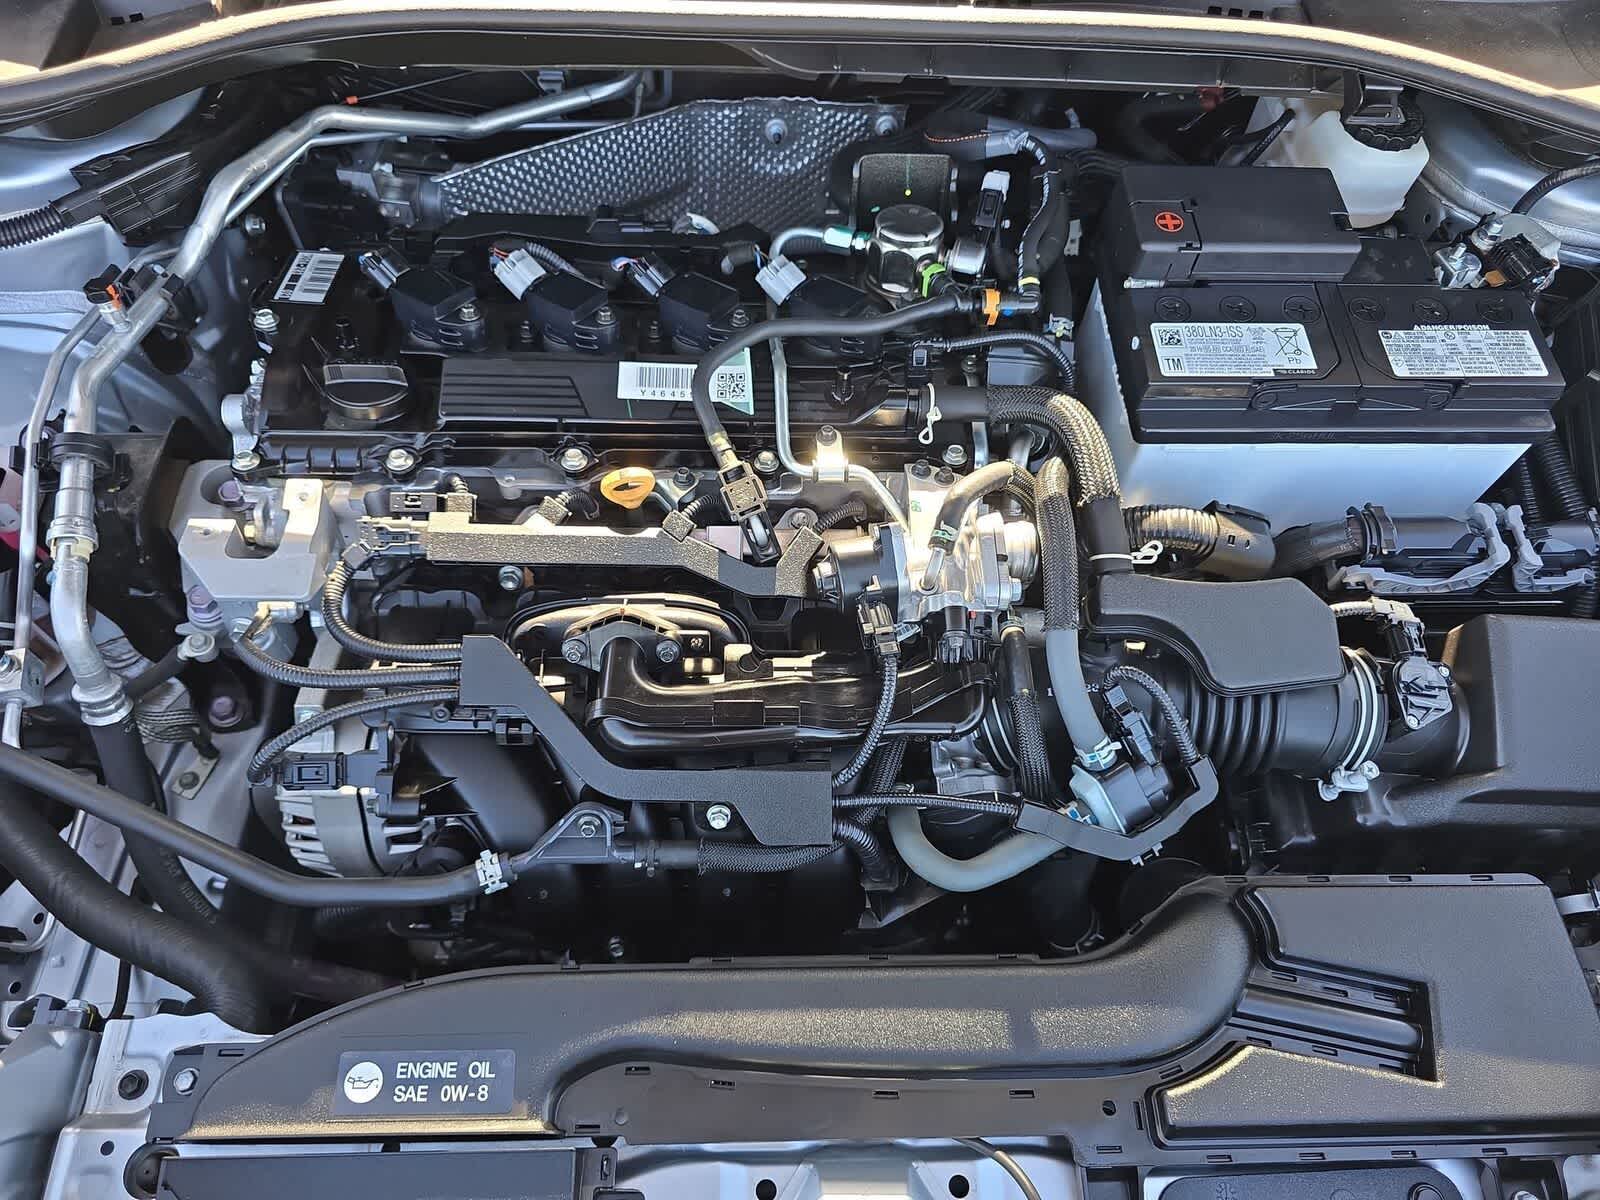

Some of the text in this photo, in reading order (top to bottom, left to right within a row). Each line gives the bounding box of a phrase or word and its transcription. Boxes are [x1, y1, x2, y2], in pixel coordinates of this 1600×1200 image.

[1184, 326, 1244, 338] 380LN3-ISS
[1164, 358, 1183, 371] TM
[1288, 356, 1302, 365] Pb
[640, 389, 692, 398] Y4645
[396, 1061, 496, 1079] ENGINE OIL
[393, 1084, 489, 1102] SAE 0W-8
